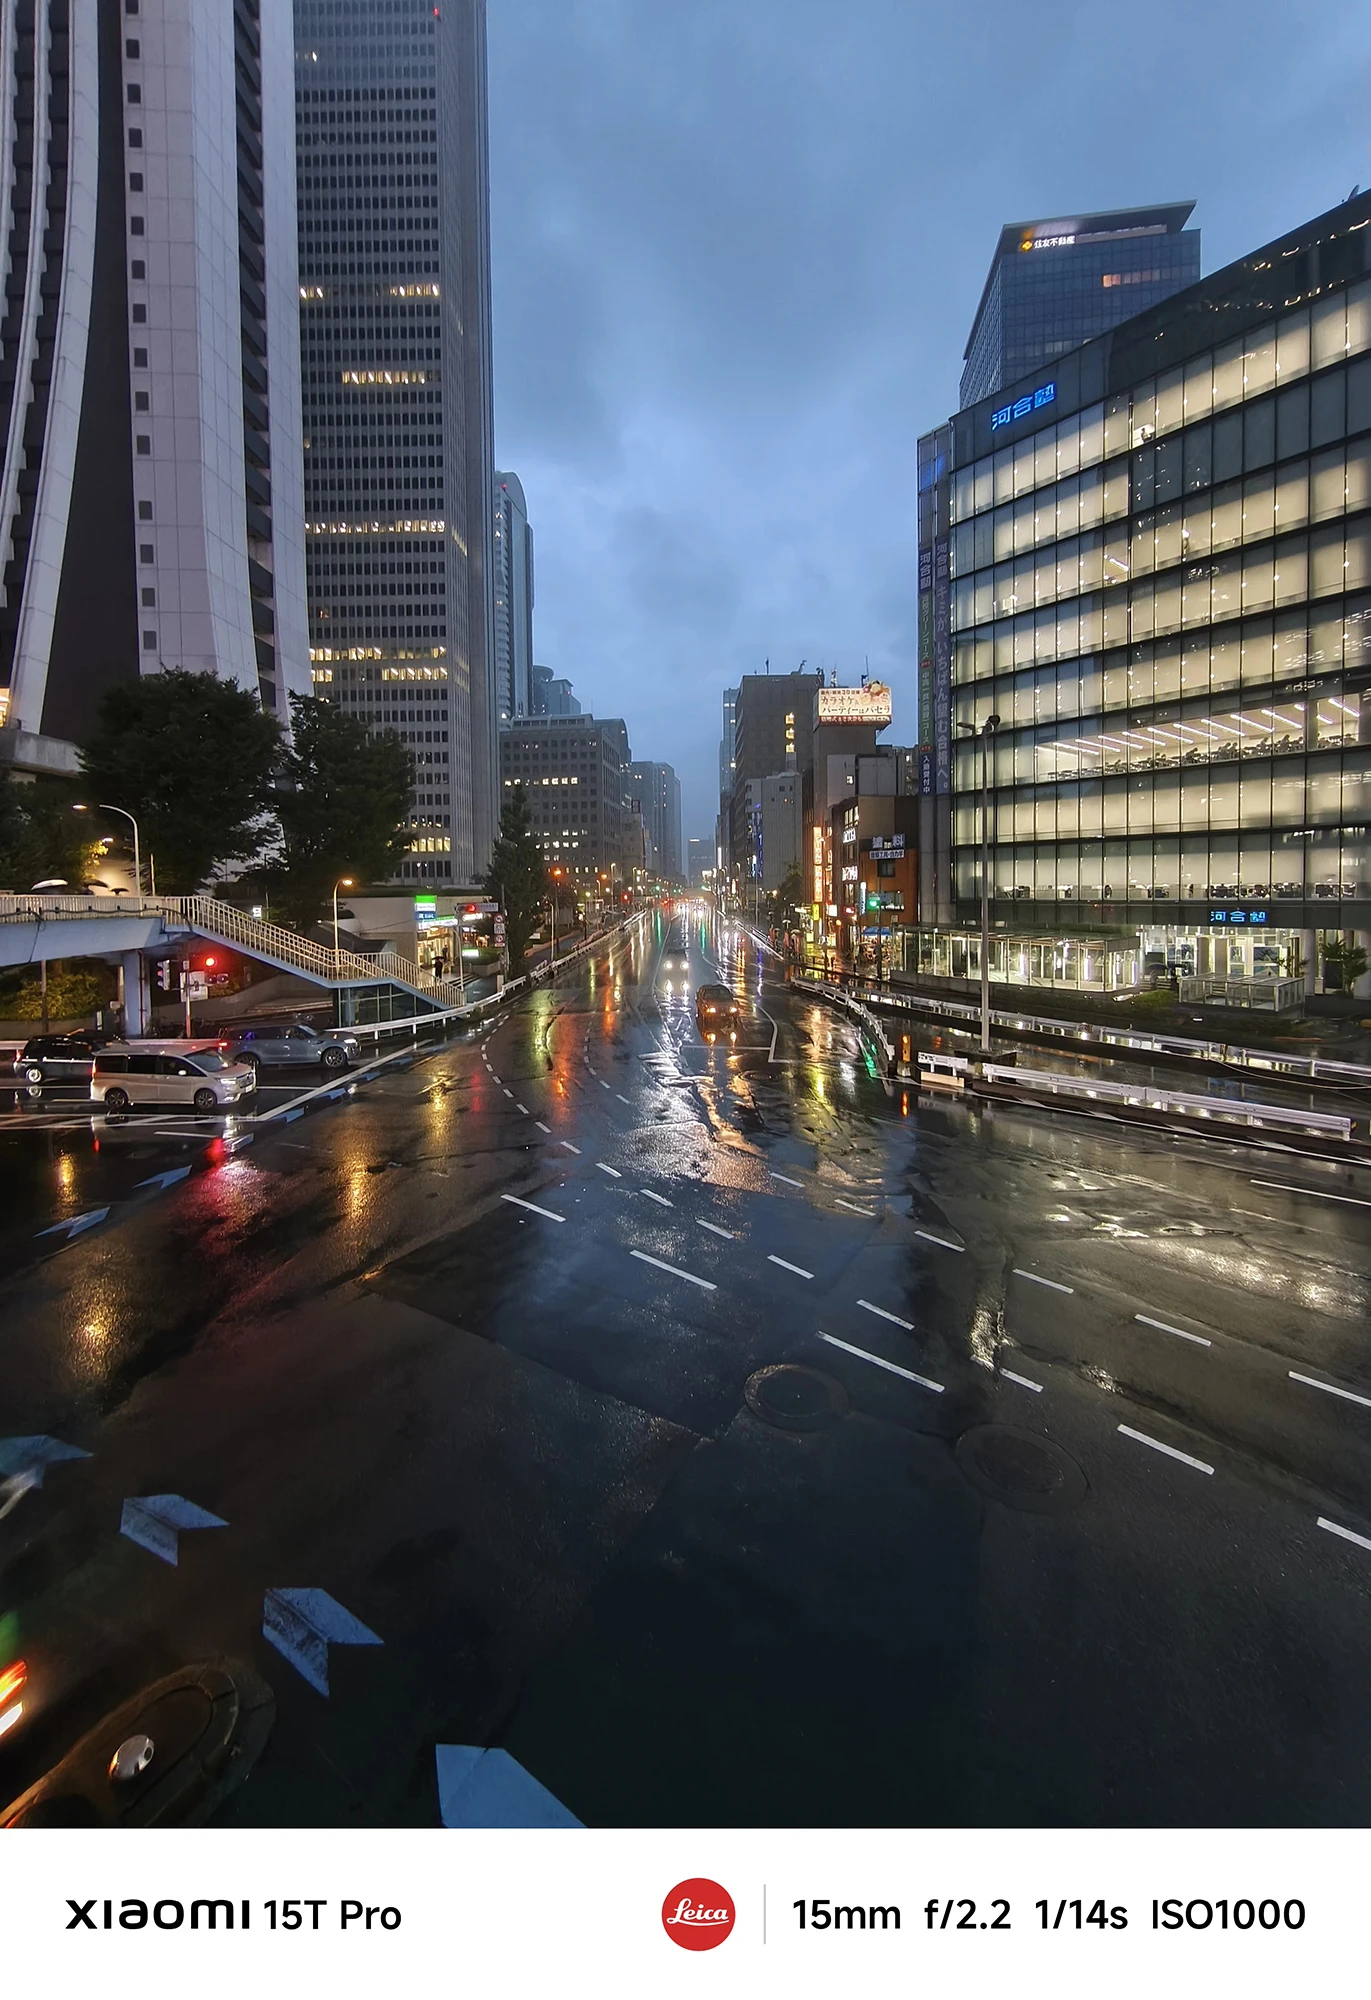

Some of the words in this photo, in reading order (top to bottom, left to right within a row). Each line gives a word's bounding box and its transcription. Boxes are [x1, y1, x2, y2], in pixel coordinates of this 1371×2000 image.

[1034, 235, 1075, 250] 住友不動産
[991, 382, 1056, 431] 河合塾
[919, 551, 931, 590] 河合塾
[936, 541, 948, 578] 河合塾
[1210, 910, 1267, 923] 河合塾
